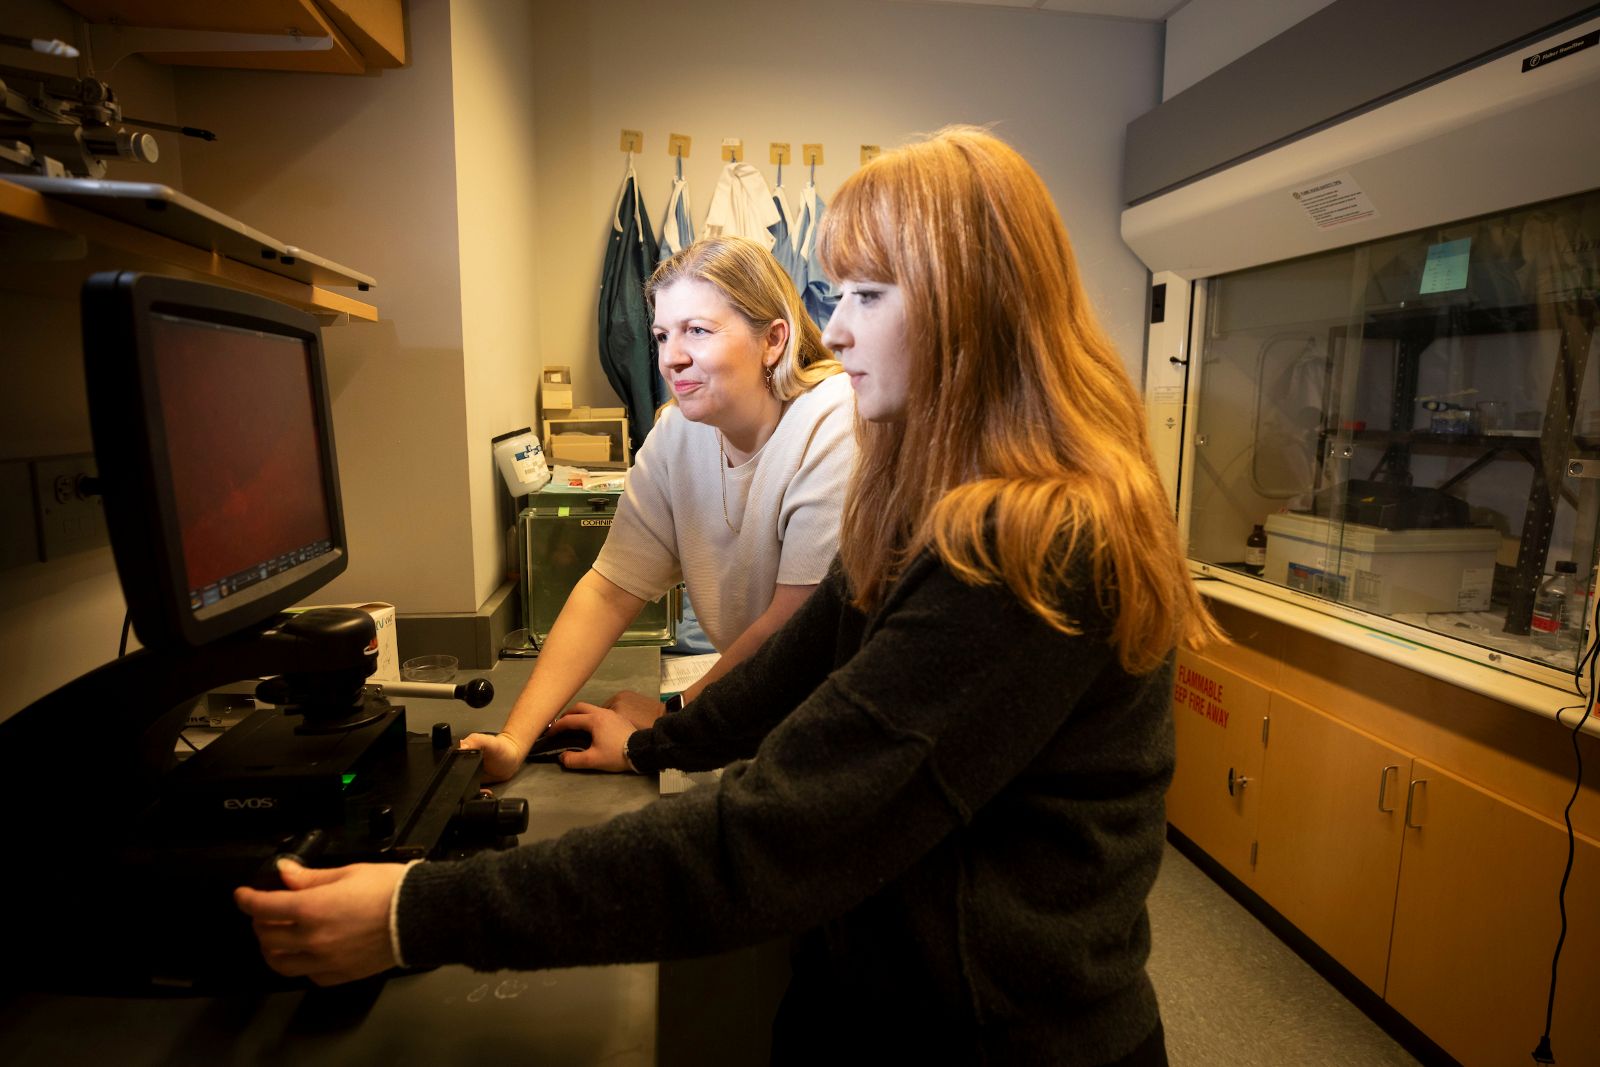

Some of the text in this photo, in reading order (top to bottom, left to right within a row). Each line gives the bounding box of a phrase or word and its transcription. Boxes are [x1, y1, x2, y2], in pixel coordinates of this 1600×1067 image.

[1178, 664, 1223, 703] FLAMMABLE
[1174, 684, 1229, 728] EEP FIRE AWAY
[223, 797, 273, 809] EVOS
